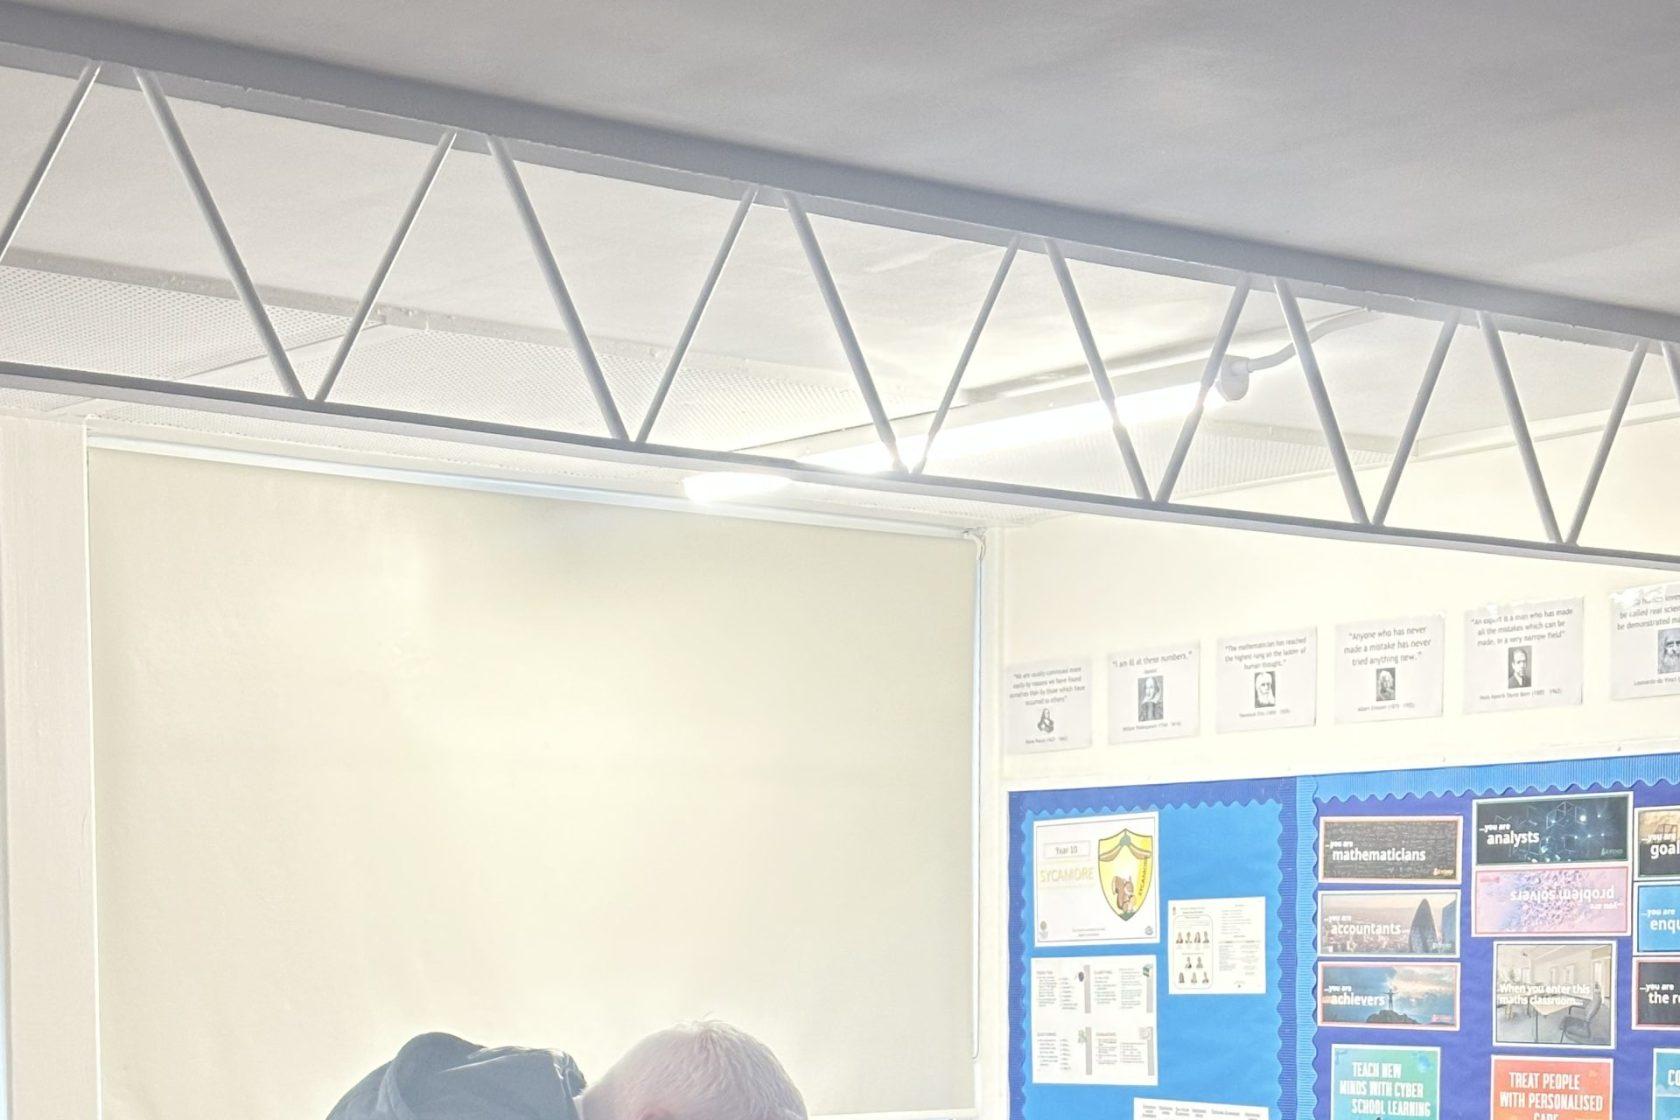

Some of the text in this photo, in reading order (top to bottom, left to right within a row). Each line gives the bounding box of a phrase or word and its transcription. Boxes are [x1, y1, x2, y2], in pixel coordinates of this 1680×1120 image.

[1498, 823, 1511, 831] are
[1486, 831, 1541, 848] analysts
[1663, 832, 1677, 841] are
[1342, 840, 1354, 848] are
[1332, 847, 1426, 862] mathematicians
[1039, 866, 1095, 883] SYCAMORE
[1558, 885, 1615, 902] problem
[1662, 908, 1677, 916] are
[1331, 923, 1401, 936] accountants
[1341, 984, 1352, 992] are
[1500, 983, 1591, 997] When you enter this
[1661, 984, 1675, 992] are
[1331, 992, 1386, 1007] achievers
[1499, 995, 1528, 1006] maths
[1648, 991, 1669, 1004] the
[1351, 1061, 1402, 1079] TEACH NEW
[1508, 1071, 1581, 1091] TREAT PEOPLE
[1339, 1079, 1424, 1099] MINDS WITH CYBER
[1351, 1098, 1432, 1118] SCHOOL LEARNING
[1499, 1090, 1604, 1113] WITH PERSONALISED
